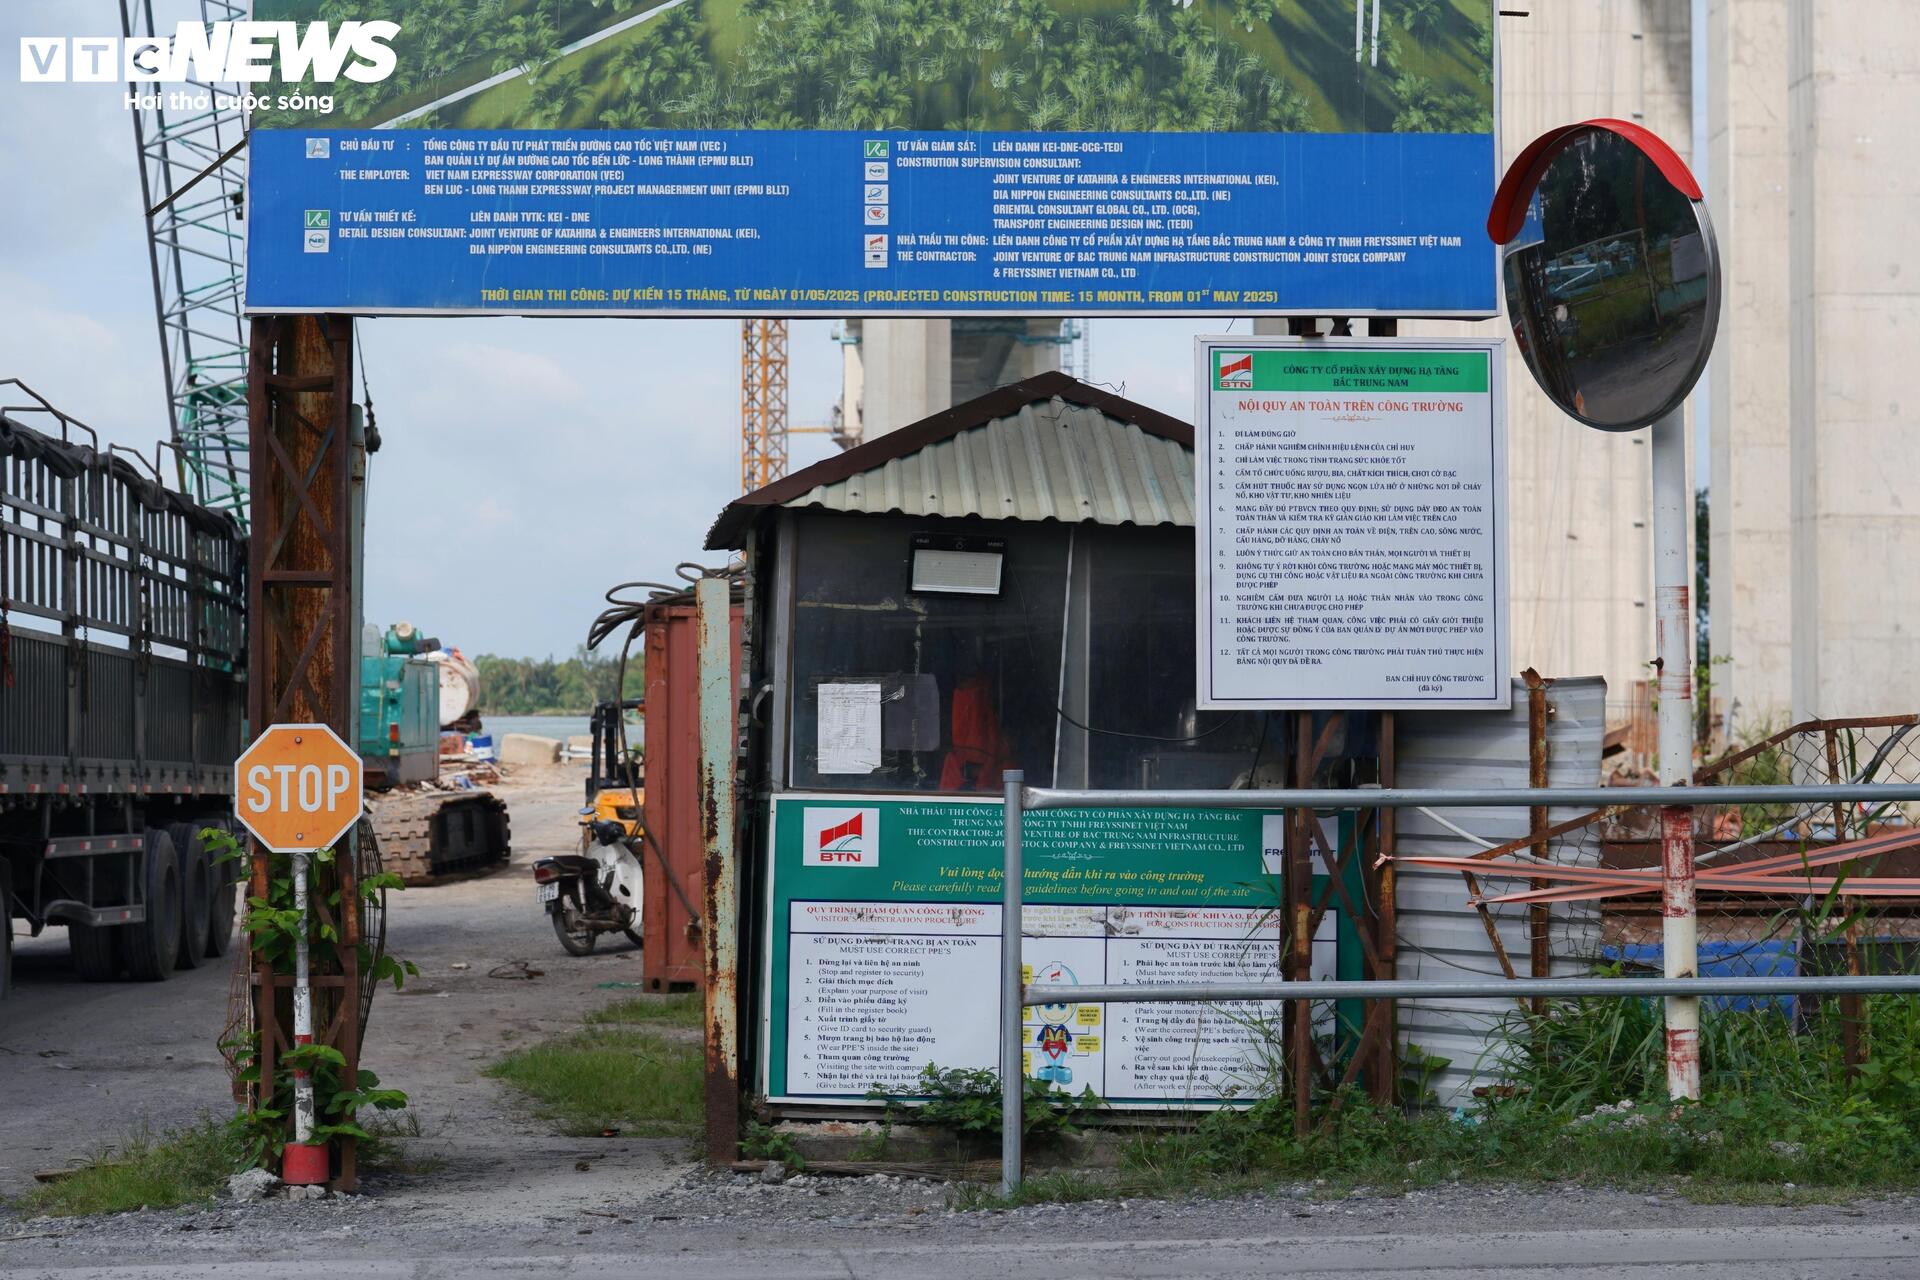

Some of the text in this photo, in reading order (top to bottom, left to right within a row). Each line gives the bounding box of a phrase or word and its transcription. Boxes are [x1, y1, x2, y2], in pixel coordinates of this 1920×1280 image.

[961, 156, 1020, 167] SUPERVISION
[1023, 157, 1080, 167] CONSULTANT:
[340, 169, 410, 180] THE EMPLOYER:
[426, 169, 623, 180] VIET NAM EXPRESSWAY CORPORATION (VEC)
[425, 185, 442, 194] BEN
[446, 185, 462, 195] LUC
[472, 185, 495, 195] LONG
[498, 185, 527, 195] THANH
[531, 185, 591, 195] EXPRESSWAY
[595, 185, 633, 195] PROJECT
[710, 185, 730, 195] UNIT
[734, 185, 762, 195] (EPMU
[766, 185, 788, 195] BLLT)
[339, 226, 759, 238] DETAIL DESIGN CONSULTANT: JOINT VENTURE OF KATAHIRA & ENGINEERS INTERNATIONAL (KEI),
[897, 250, 977, 261] THE CONTRACTOR:
[993, 251, 1405, 262] JOINT VENTURE OF BAC TRUNG NAM INFRASTRUCTURE CONSTRUCTION JOINT STOCK COMPANY
[993, 266, 1135, 278] & FREYSSINET VIETNAM CO., LTD
[482, 287, 508, 300] THỜI
[513, 290, 543, 300] GIAN
[547, 290, 565, 300] THI
[570, 287, 608, 300] CÔNG:
[634, 286, 662, 299] KIẾN
[668, 289, 681, 299] 15
[685, 287, 729, 301] THÁNG,
[753, 287, 785, 300] NGÀY
[790, 287, 858, 300] 01/05/2025
[864, 288, 938, 304] (PROJECTED
[943, 287, 1036, 301] CONSTRUCTION
[1041, 291, 1074, 301] TIME:
[1079, 288, 1092, 301] 15
[1097, 287, 1144, 302] MONTH,
[1148, 291, 1183, 302] FROM
[1213, 291, 1239, 301] MAY
[1243, 291, 1277, 302] 2025)
[1283, 363, 1308, 373] CÔNG
[1310, 366, 1323, 374] TY
[1388, 367, 1416, 377] DỰNG
[1418, 367, 1431, 377] HẠ
[1333, 377, 1408, 387] BẮC TRUNG NAM
[1238, 398, 1463, 412] NỘI QUY AN TOÀN TRÊN CÔNG TRƯỜNG
[247, 764, 350, 813] STOP
[820, 852, 862, 863] BTN
[939, 866, 958, 876] Vui
[960, 867, 983, 879] lòng
[1084, 869, 1102, 879] khi
[1104, 872, 1115, 880] ra
[1119, 869, 1137, 879] vào
[1140, 870, 1165, 882] công
[890, 881, 1249, 898] Please carefully read guidelines before going in and out of the site
[839, 946, 863, 954] MUST
[866, 945, 883, 954] USE
[884, 947, 926, 955] CORRECT
[818, 968, 838, 977] (Stop
[893, 970, 924, 978] security)
[818, 987, 848, 996] (Explain
[818, 1005, 833, 1014] (Fill
